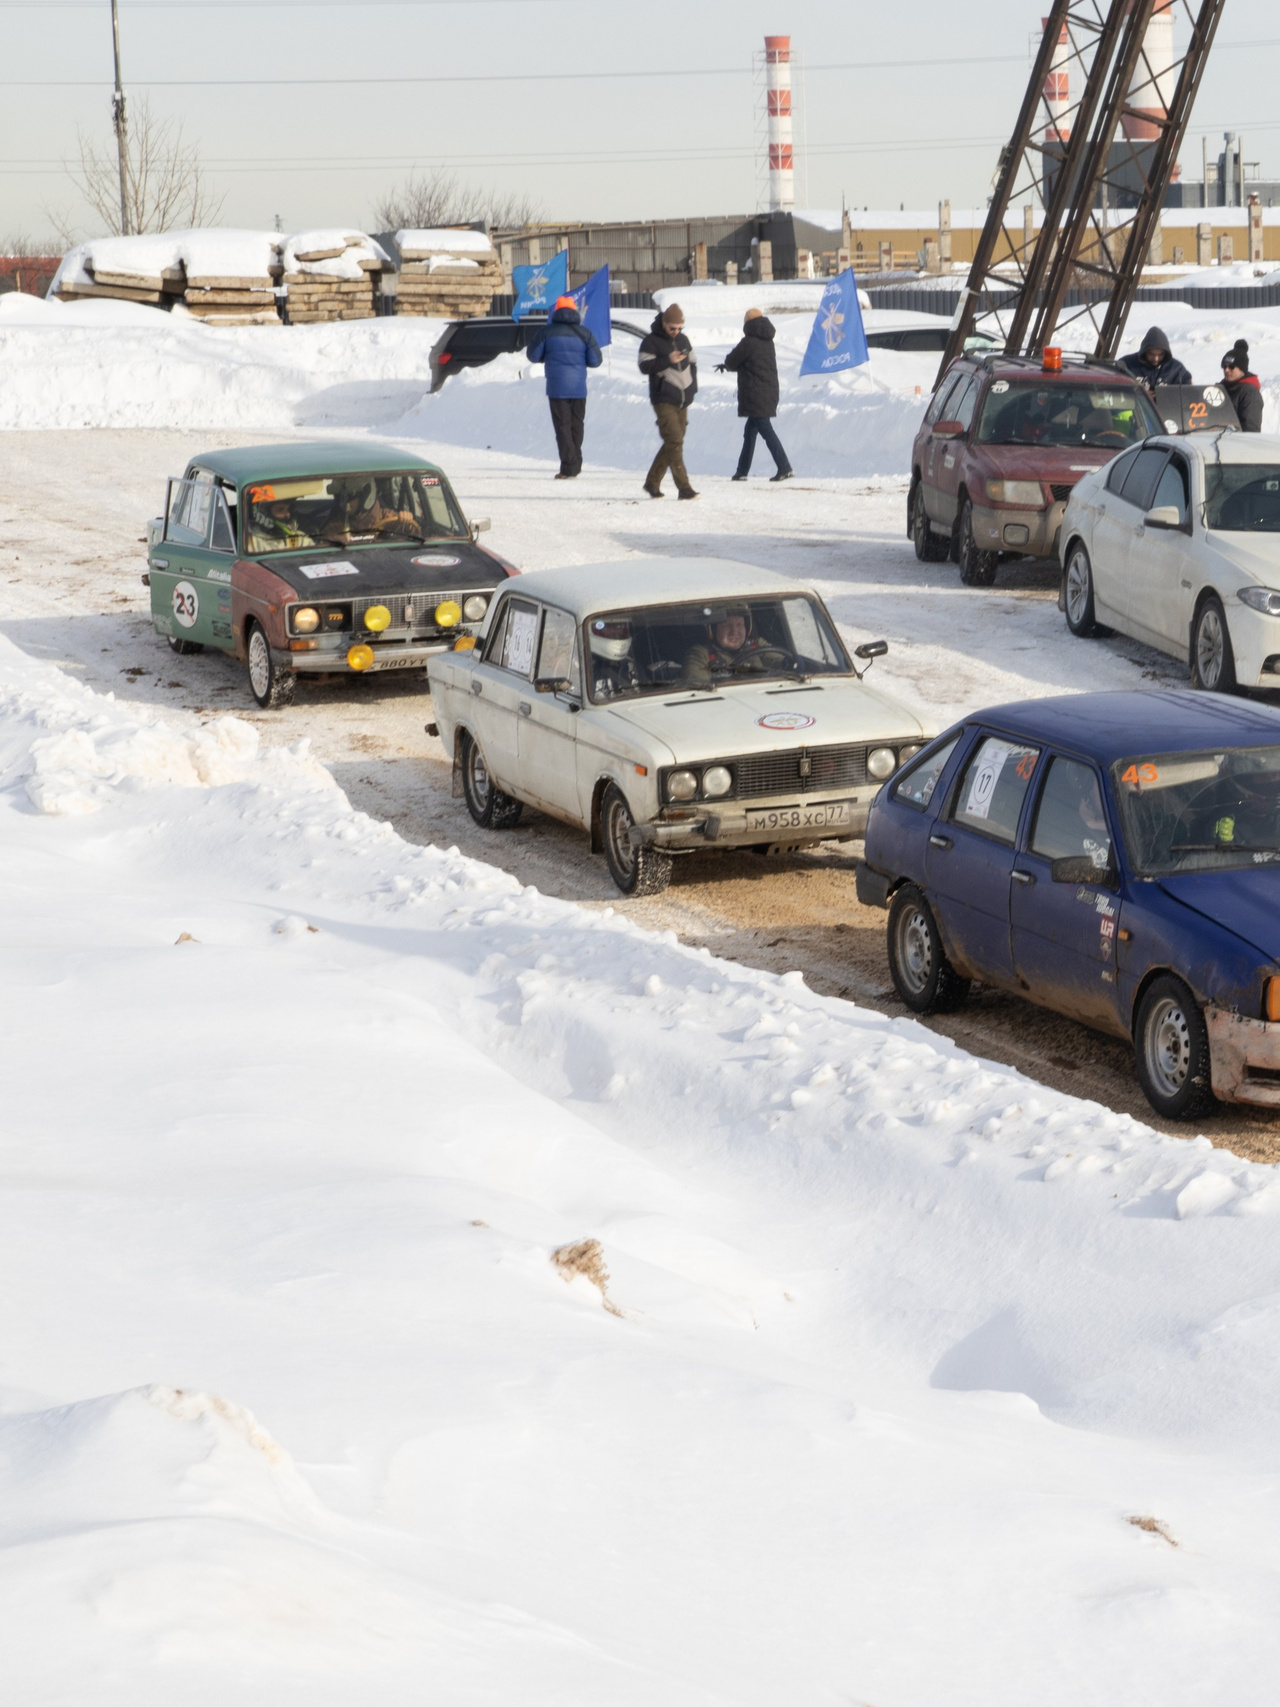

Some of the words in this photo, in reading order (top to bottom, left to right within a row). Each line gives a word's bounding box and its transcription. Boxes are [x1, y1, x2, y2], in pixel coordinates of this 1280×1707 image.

[1189, 402, 1208, 418] 22
[176, 592, 195, 617] 23
[370, 658, 425, 671] 880УТ
[1015, 753, 1038, 780] 43
[1121, 763, 1159, 784] 43
[979, 773, 992, 794] 17
[754, 811, 825, 830] М958ХС
[829, 806, 844, 819] 77
